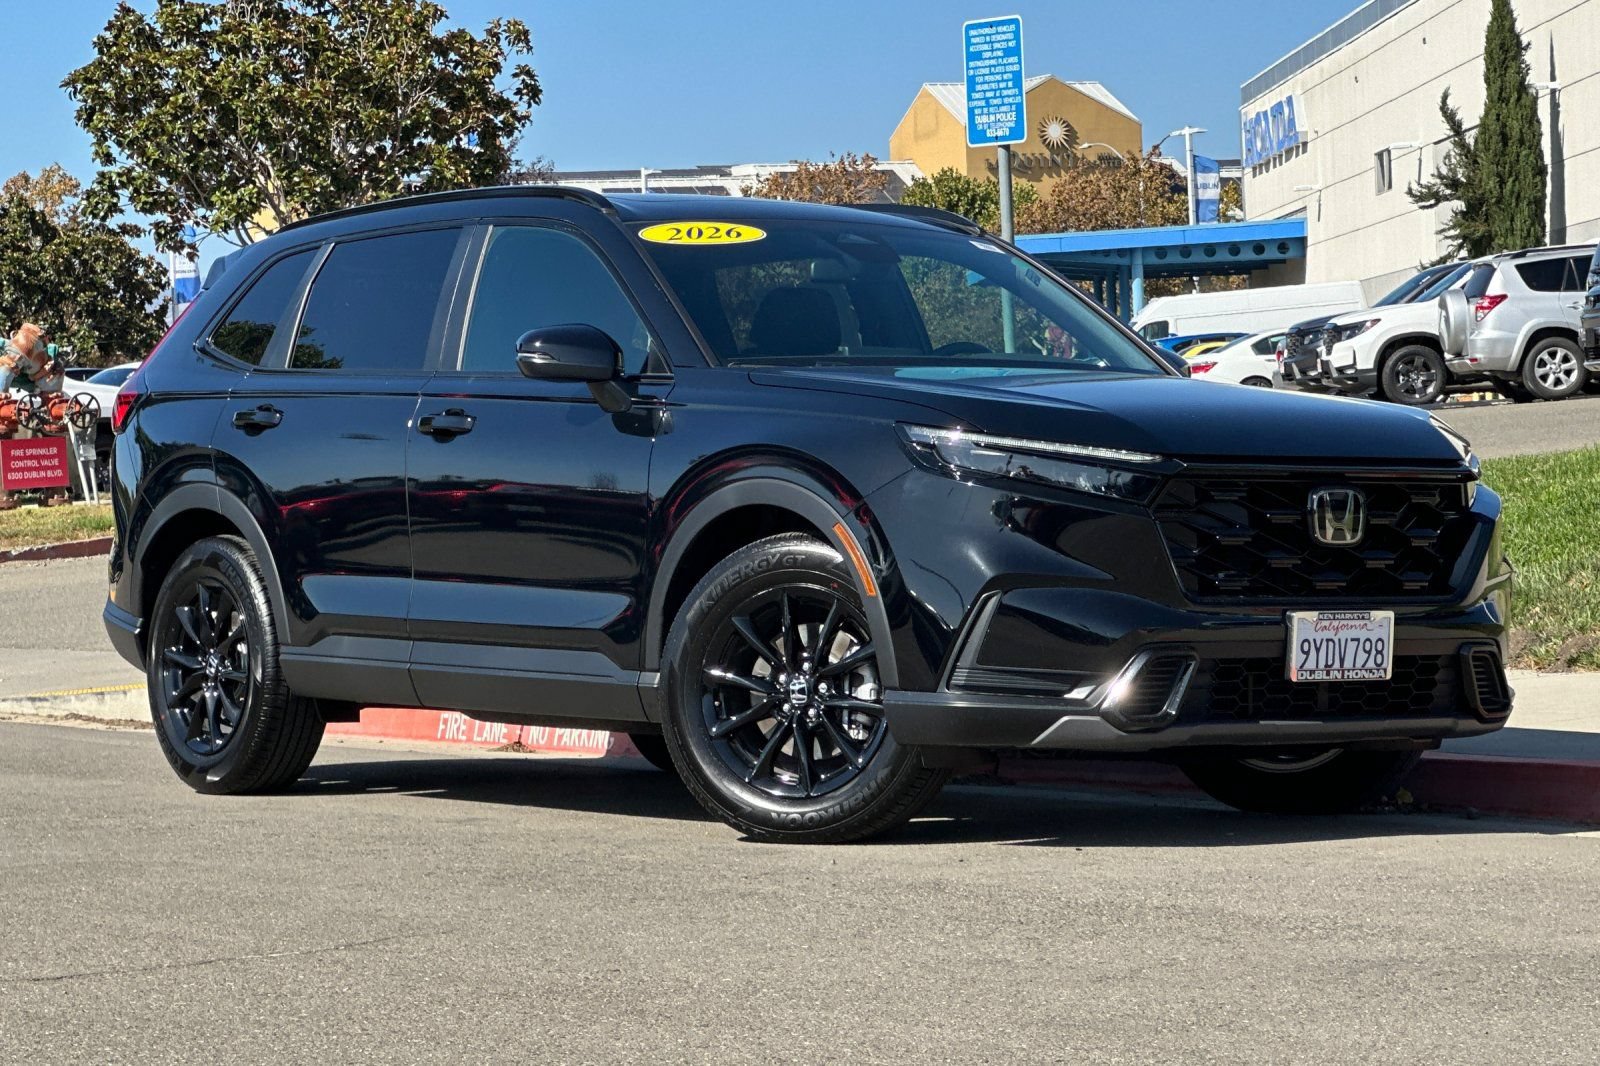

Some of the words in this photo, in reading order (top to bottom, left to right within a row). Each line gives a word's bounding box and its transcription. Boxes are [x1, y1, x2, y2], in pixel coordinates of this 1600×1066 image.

[997, 24, 1016, 32] VEHICLES
[992, 41, 1008, 49] SPACES
[982, 50, 1004, 58] DISPLAYING
[998, 56, 1018, 65] PLACARDS
[975, 67, 990, 75] LICENSE
[1006, 64, 1020, 72] ISSUED
[984, 74, 1002, 82] PERSONS
[1003, 96, 1021, 104] VEHICLES
[975, 114, 996, 124] DUBLIN
[996, 112, 1016, 122] POLICE
[1242, 94, 1301, 168] HONDA
[666, 226, 742, 241] 2026
[11, 449, 24, 457] FIRE
[25, 447, 58, 456] SPRINKLER
[10, 460, 40, 469] CONTROL
[40, 458, 60, 466] VALVE
[7, 472, 23, 480] 6300
[24, 470, 46, 479] DUBLIN
[1335, 612, 1370, 620] HARVEY'S
[1314, 621, 1374, 636] California
[1300, 637, 1385, 669] 9YDV798
[1297, 670, 1342, 680] DUBLIN
[1344, 669, 1386, 679] HONDA
[437, 713, 468, 740] FIRE
[473, 721, 510, 744] LANE
[528, 725, 549, 744] NO
